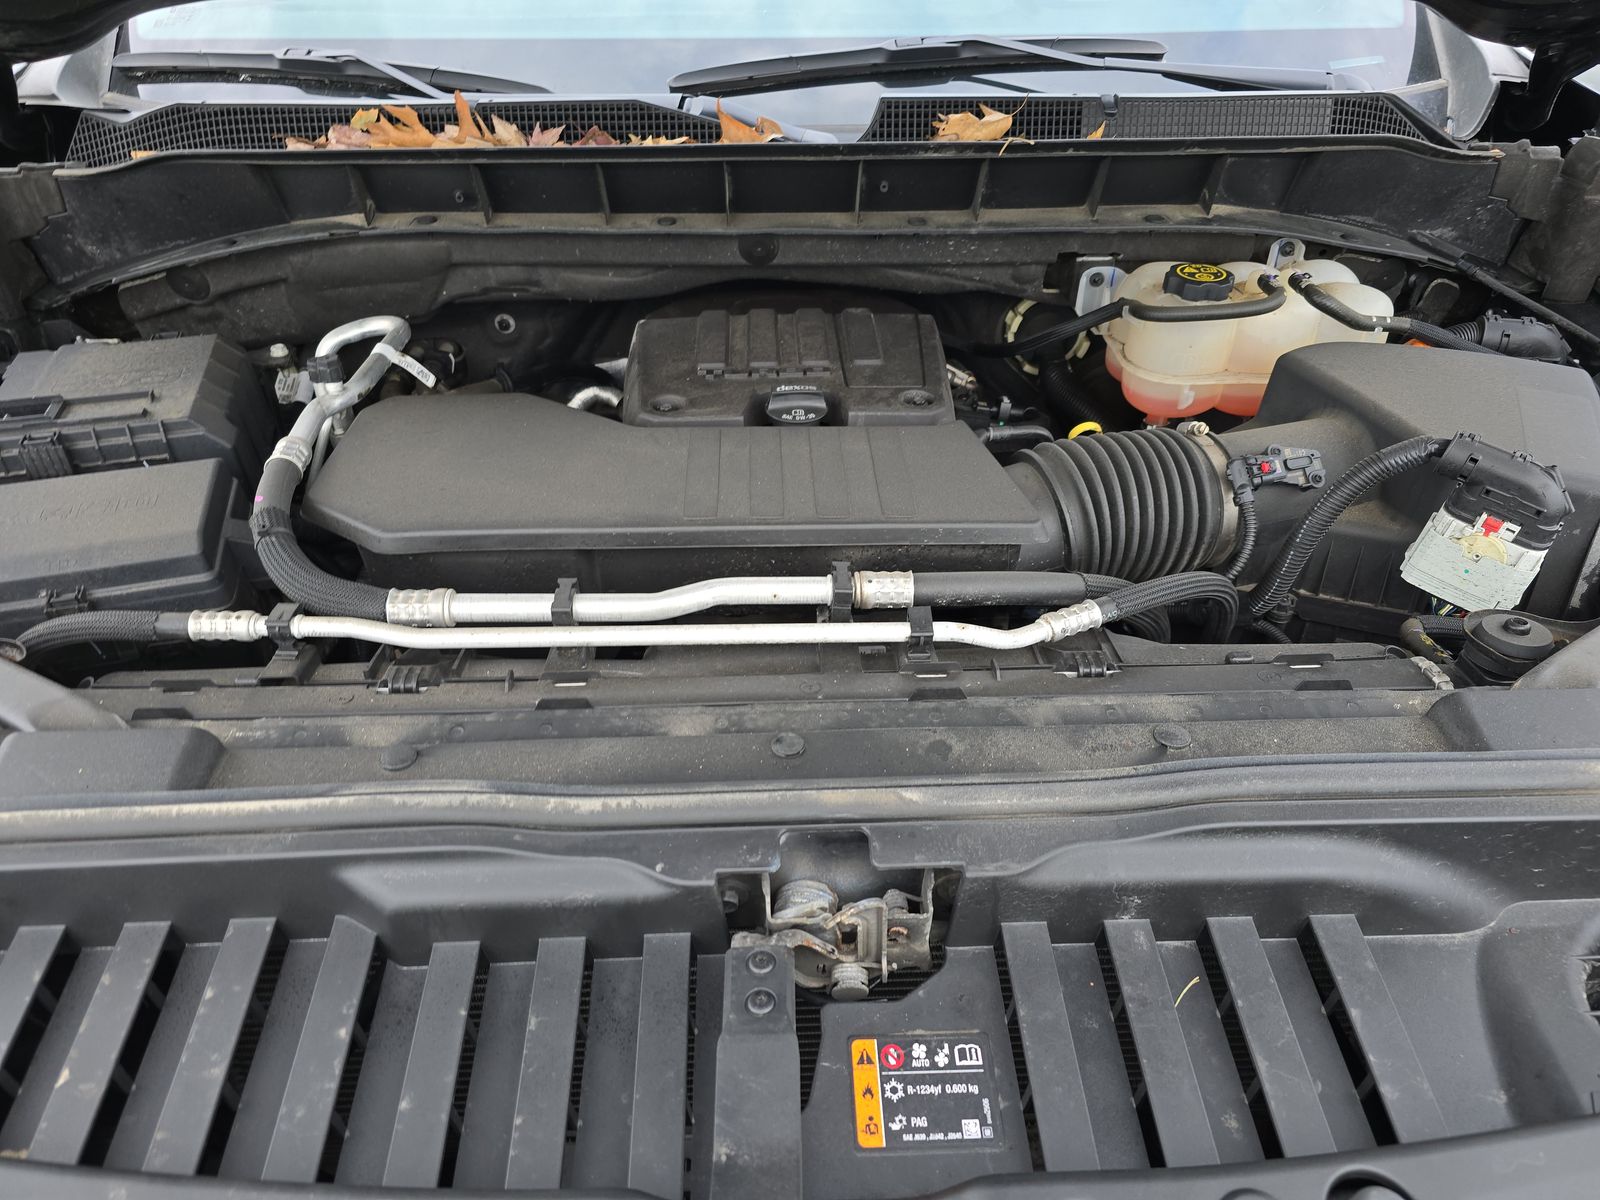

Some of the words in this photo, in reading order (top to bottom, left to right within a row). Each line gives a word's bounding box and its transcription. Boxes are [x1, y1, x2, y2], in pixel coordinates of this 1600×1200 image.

[911, 1058, 930, 1068] AUTO
[907, 1084, 942, 1096] R-1234yf
[945, 1083, 967, 1094] 0.600
[968, 1083, 979, 1095] kg
[910, 1116, 928, 1127] PAG
